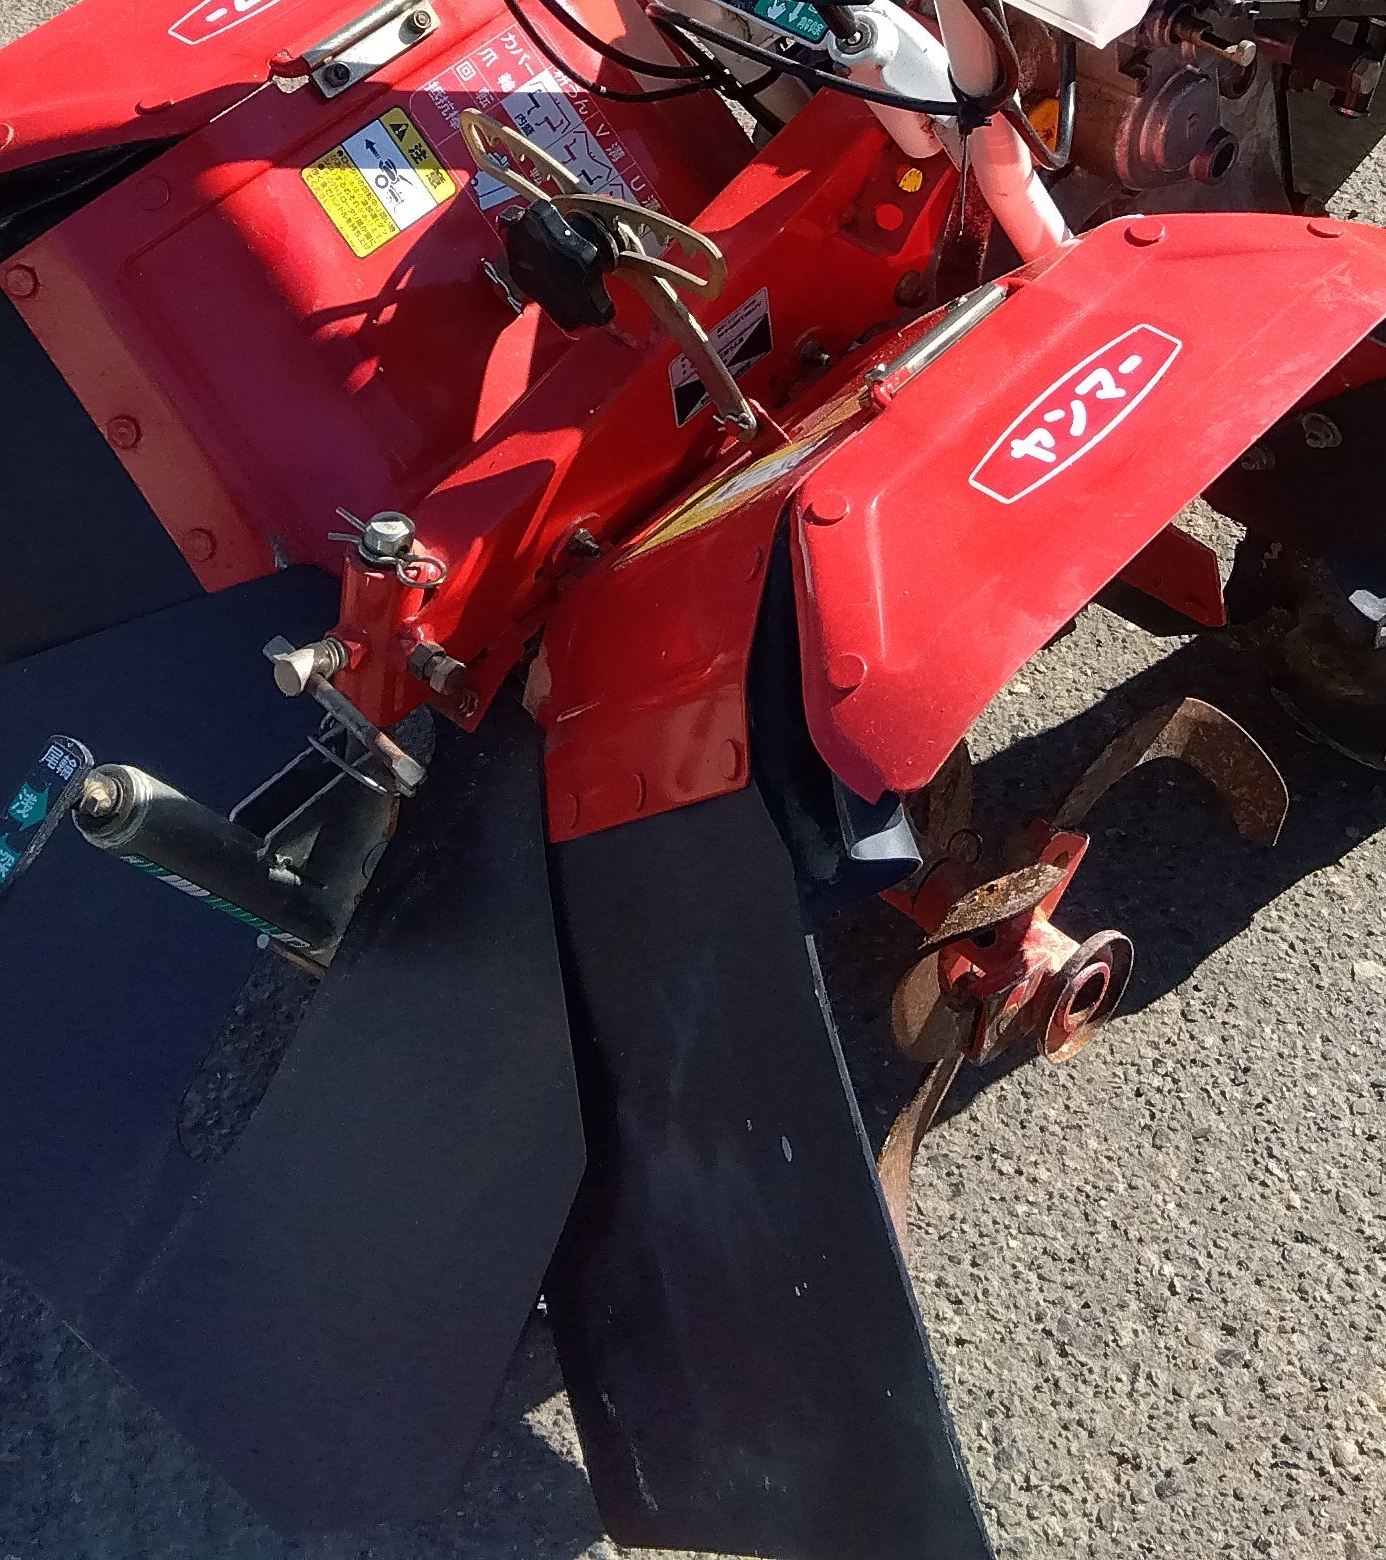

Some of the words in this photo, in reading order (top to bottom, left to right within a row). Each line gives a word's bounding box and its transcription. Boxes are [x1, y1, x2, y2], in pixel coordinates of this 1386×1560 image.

[500, 31, 536, 77] カバー
[1009, 354, 1143, 463] ヤンマー
[38, 744, 78, 781] 尾輪
[9, 787, 38, 819] 浅
